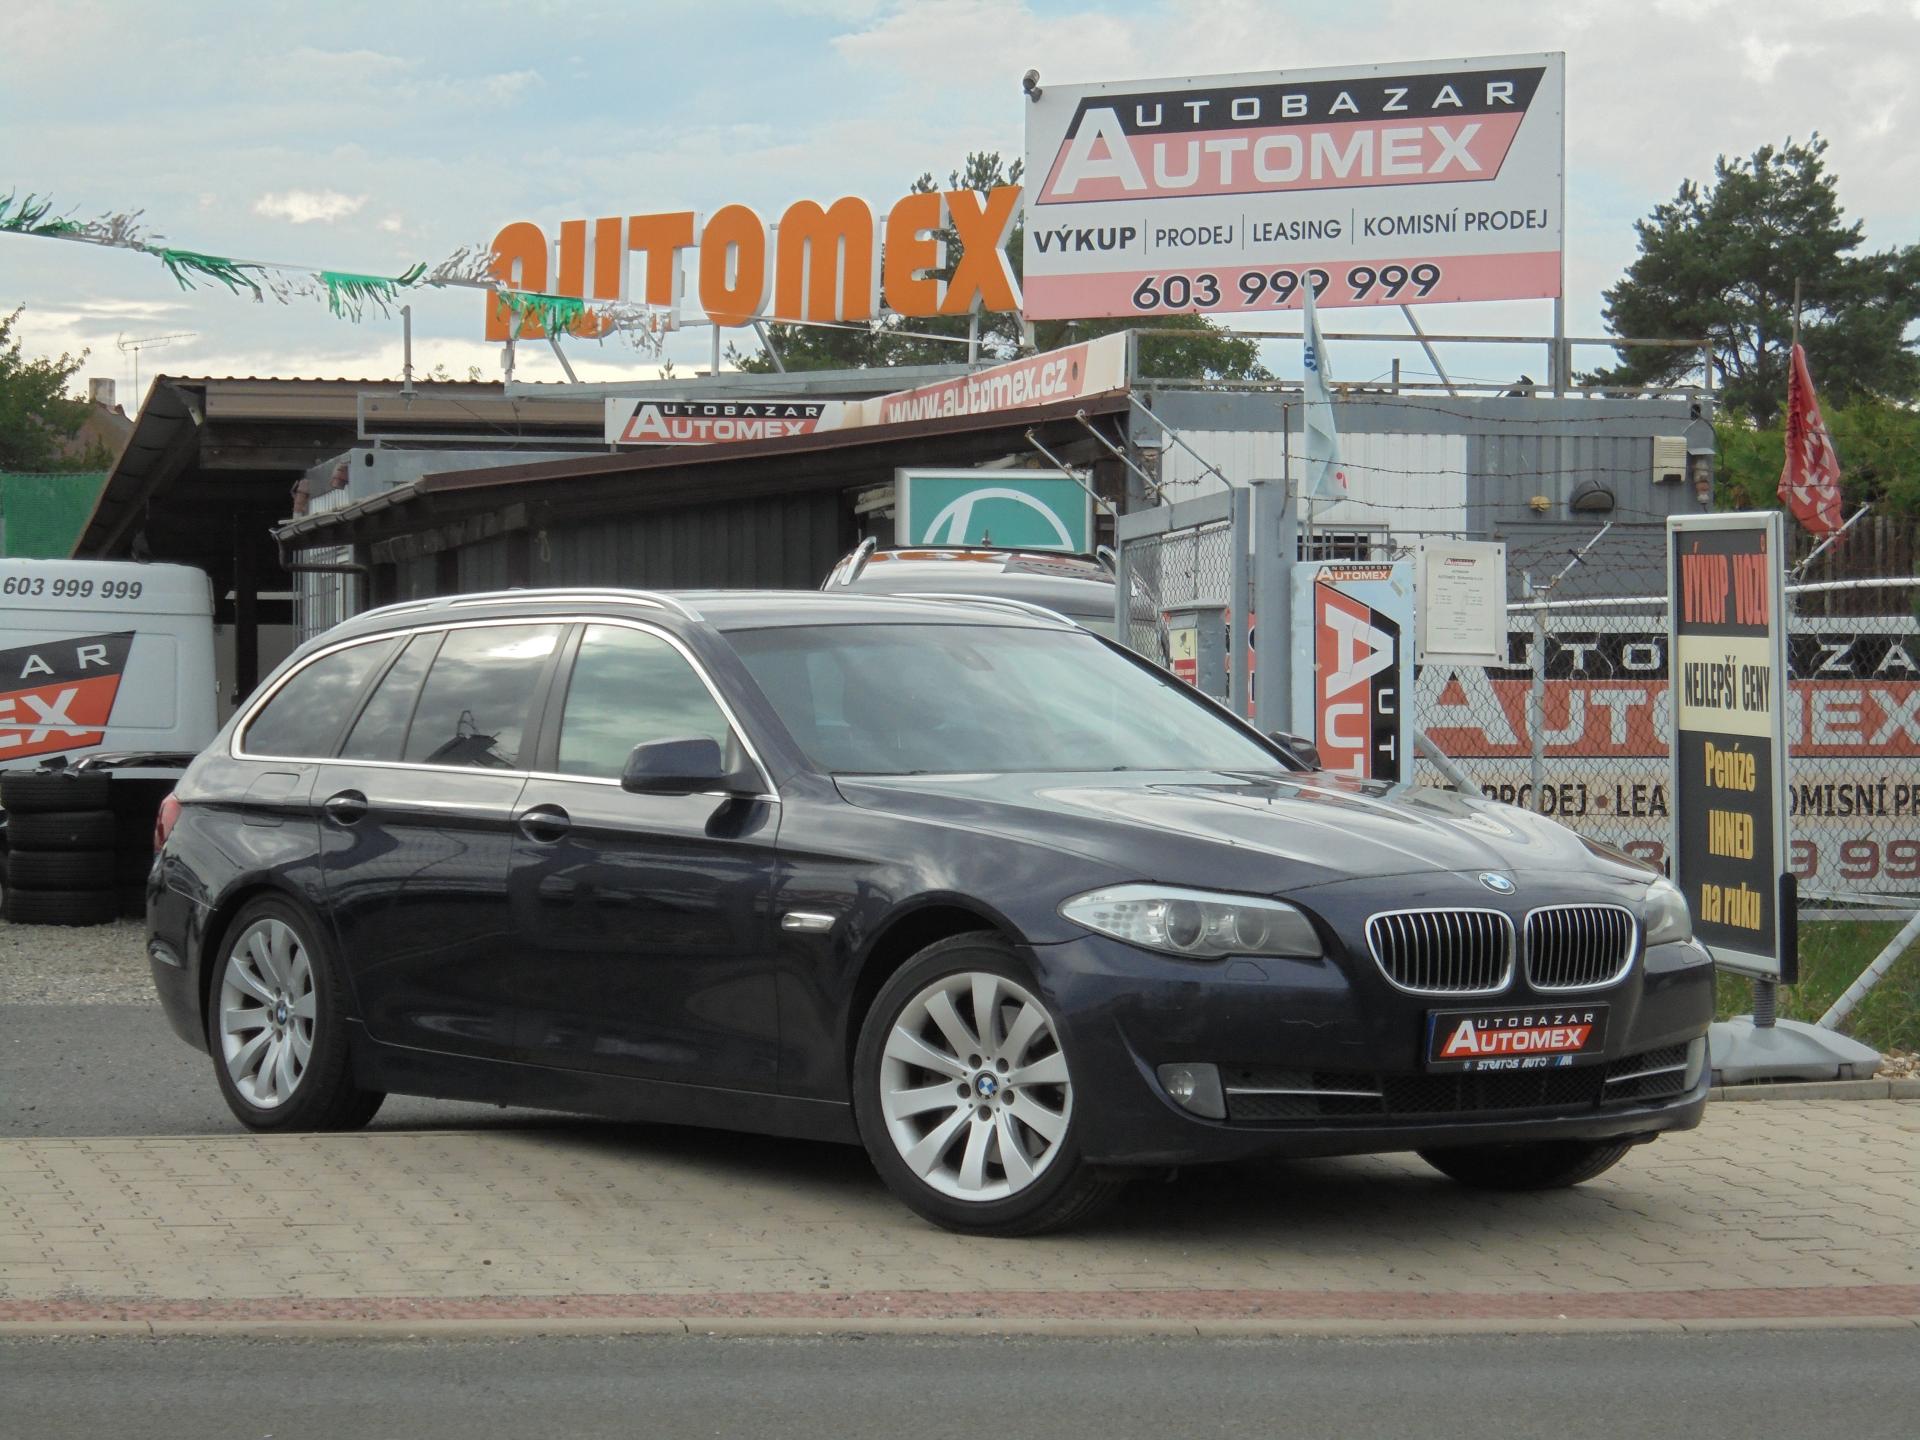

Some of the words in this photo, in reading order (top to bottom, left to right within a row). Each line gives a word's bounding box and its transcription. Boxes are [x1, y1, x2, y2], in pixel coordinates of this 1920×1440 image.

[1050, 107, 1483, 195] AUTOMEX
[1033, 224, 1136, 254] VÝKUP
[1155, 224, 1233, 248] PRODEJ
[1253, 218, 1342, 243] LEASING
[1364, 207, 1459, 237] KOMISNÍ
[1465, 209, 1548, 232] PRODEJ
[485, 185, 1023, 341] AUTOMEX
[1133, 274, 1221, 310] 603
[1239, 268, 1330, 306] 999
[1347, 263, 1441, 300] 999
[888, 357, 1068, 424] www.automex.cz
[628, 404, 806, 440] AUTOMEX
[3, 577, 45, 596] 603
[52, 579, 94, 598] 999
[100, 581, 143, 599] 999
[1316, 566, 1388, 581] AUTOMEX
[1682, 541, 1728, 624] VÝKUP
[1684, 655, 1737, 710] NEJLEPŠÍ
[1742, 665, 1770, 713] CENY
[1704, 741, 1756, 793] Peníze
[1708, 809, 1754, 860] IHNED
[1701, 883, 1721, 924] na
[1723, 882, 1761, 931] ruku
[1447, 1020, 1583, 1054] AUTOMEX
